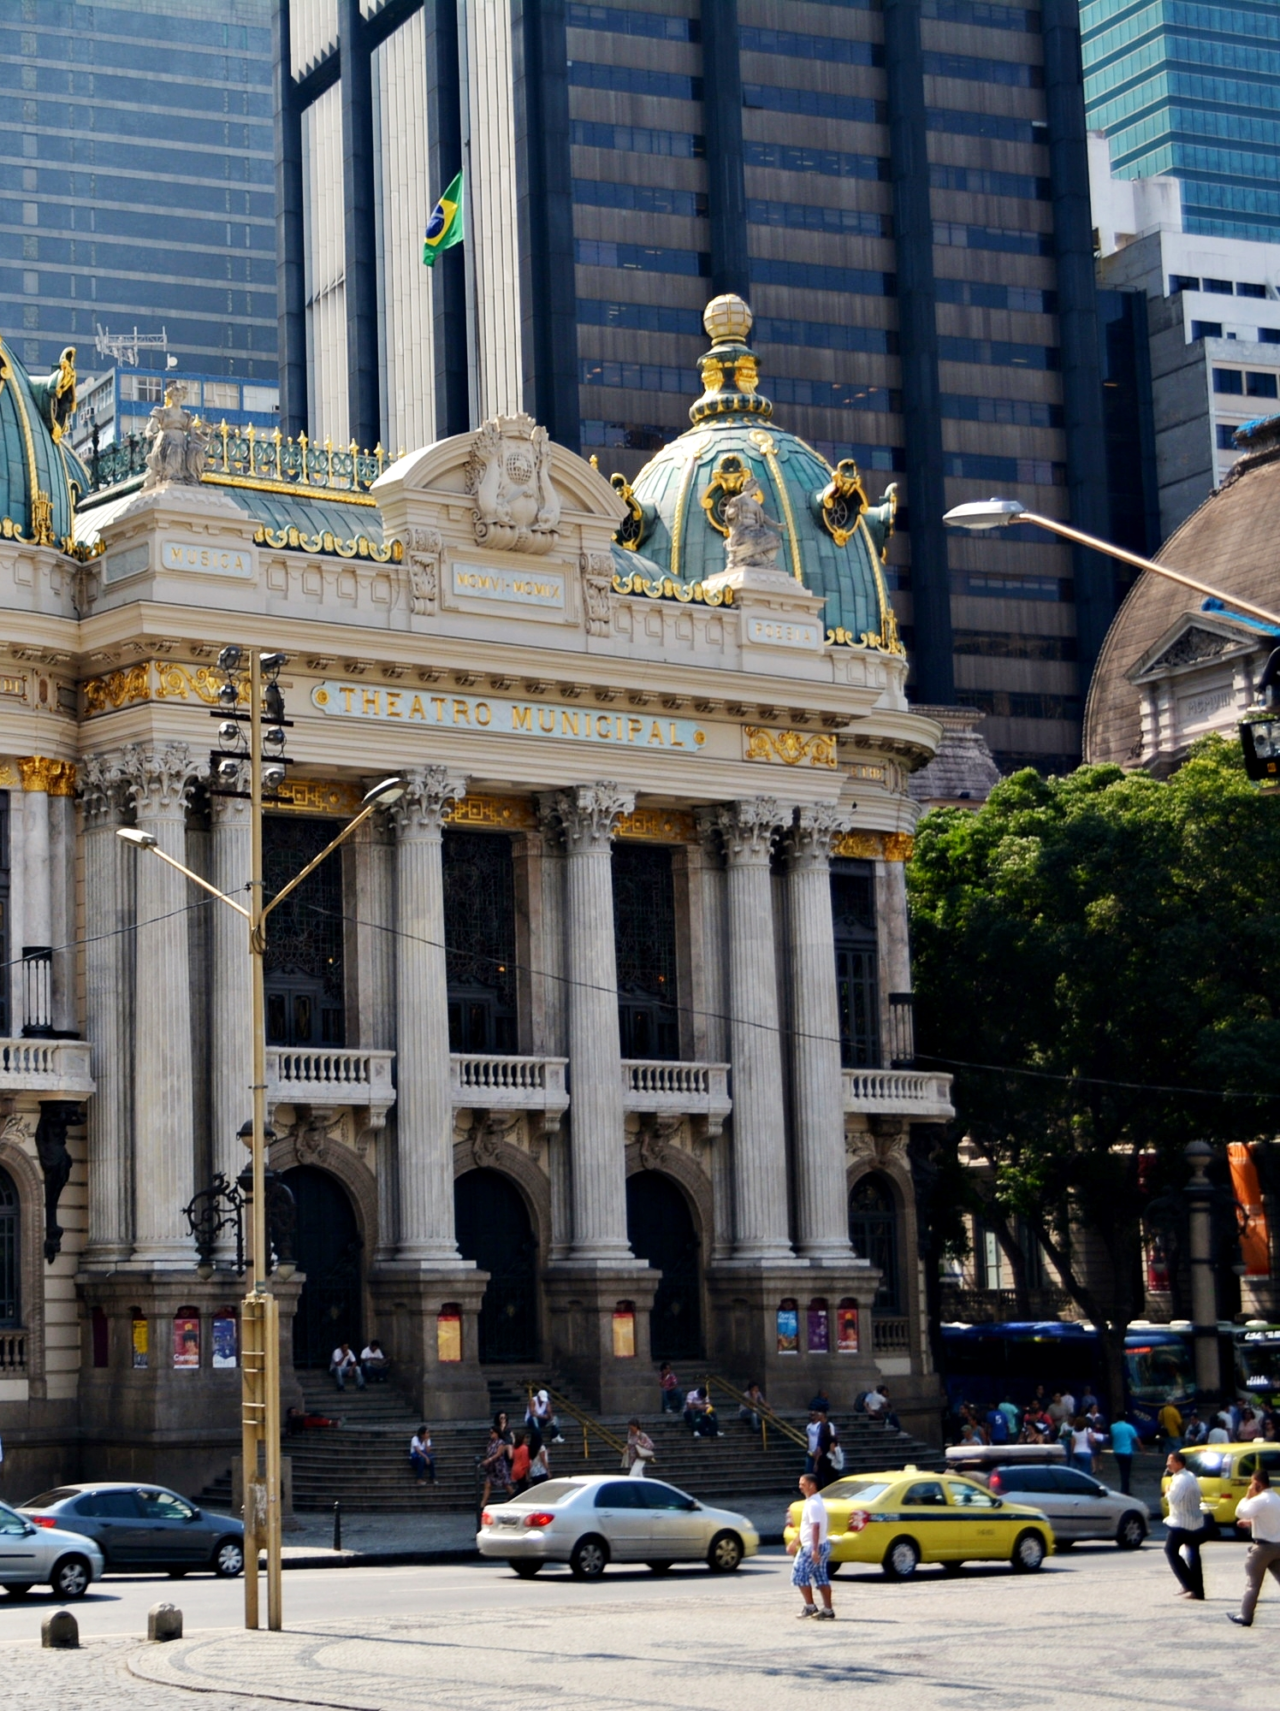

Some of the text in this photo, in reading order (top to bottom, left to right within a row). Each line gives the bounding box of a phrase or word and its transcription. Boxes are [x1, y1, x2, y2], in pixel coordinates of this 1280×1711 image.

[170, 547, 244, 571] MUSICA
[755, 622, 811, 642] POESIA
[339, 687, 685, 747] THEATRO MUNICIPAL
